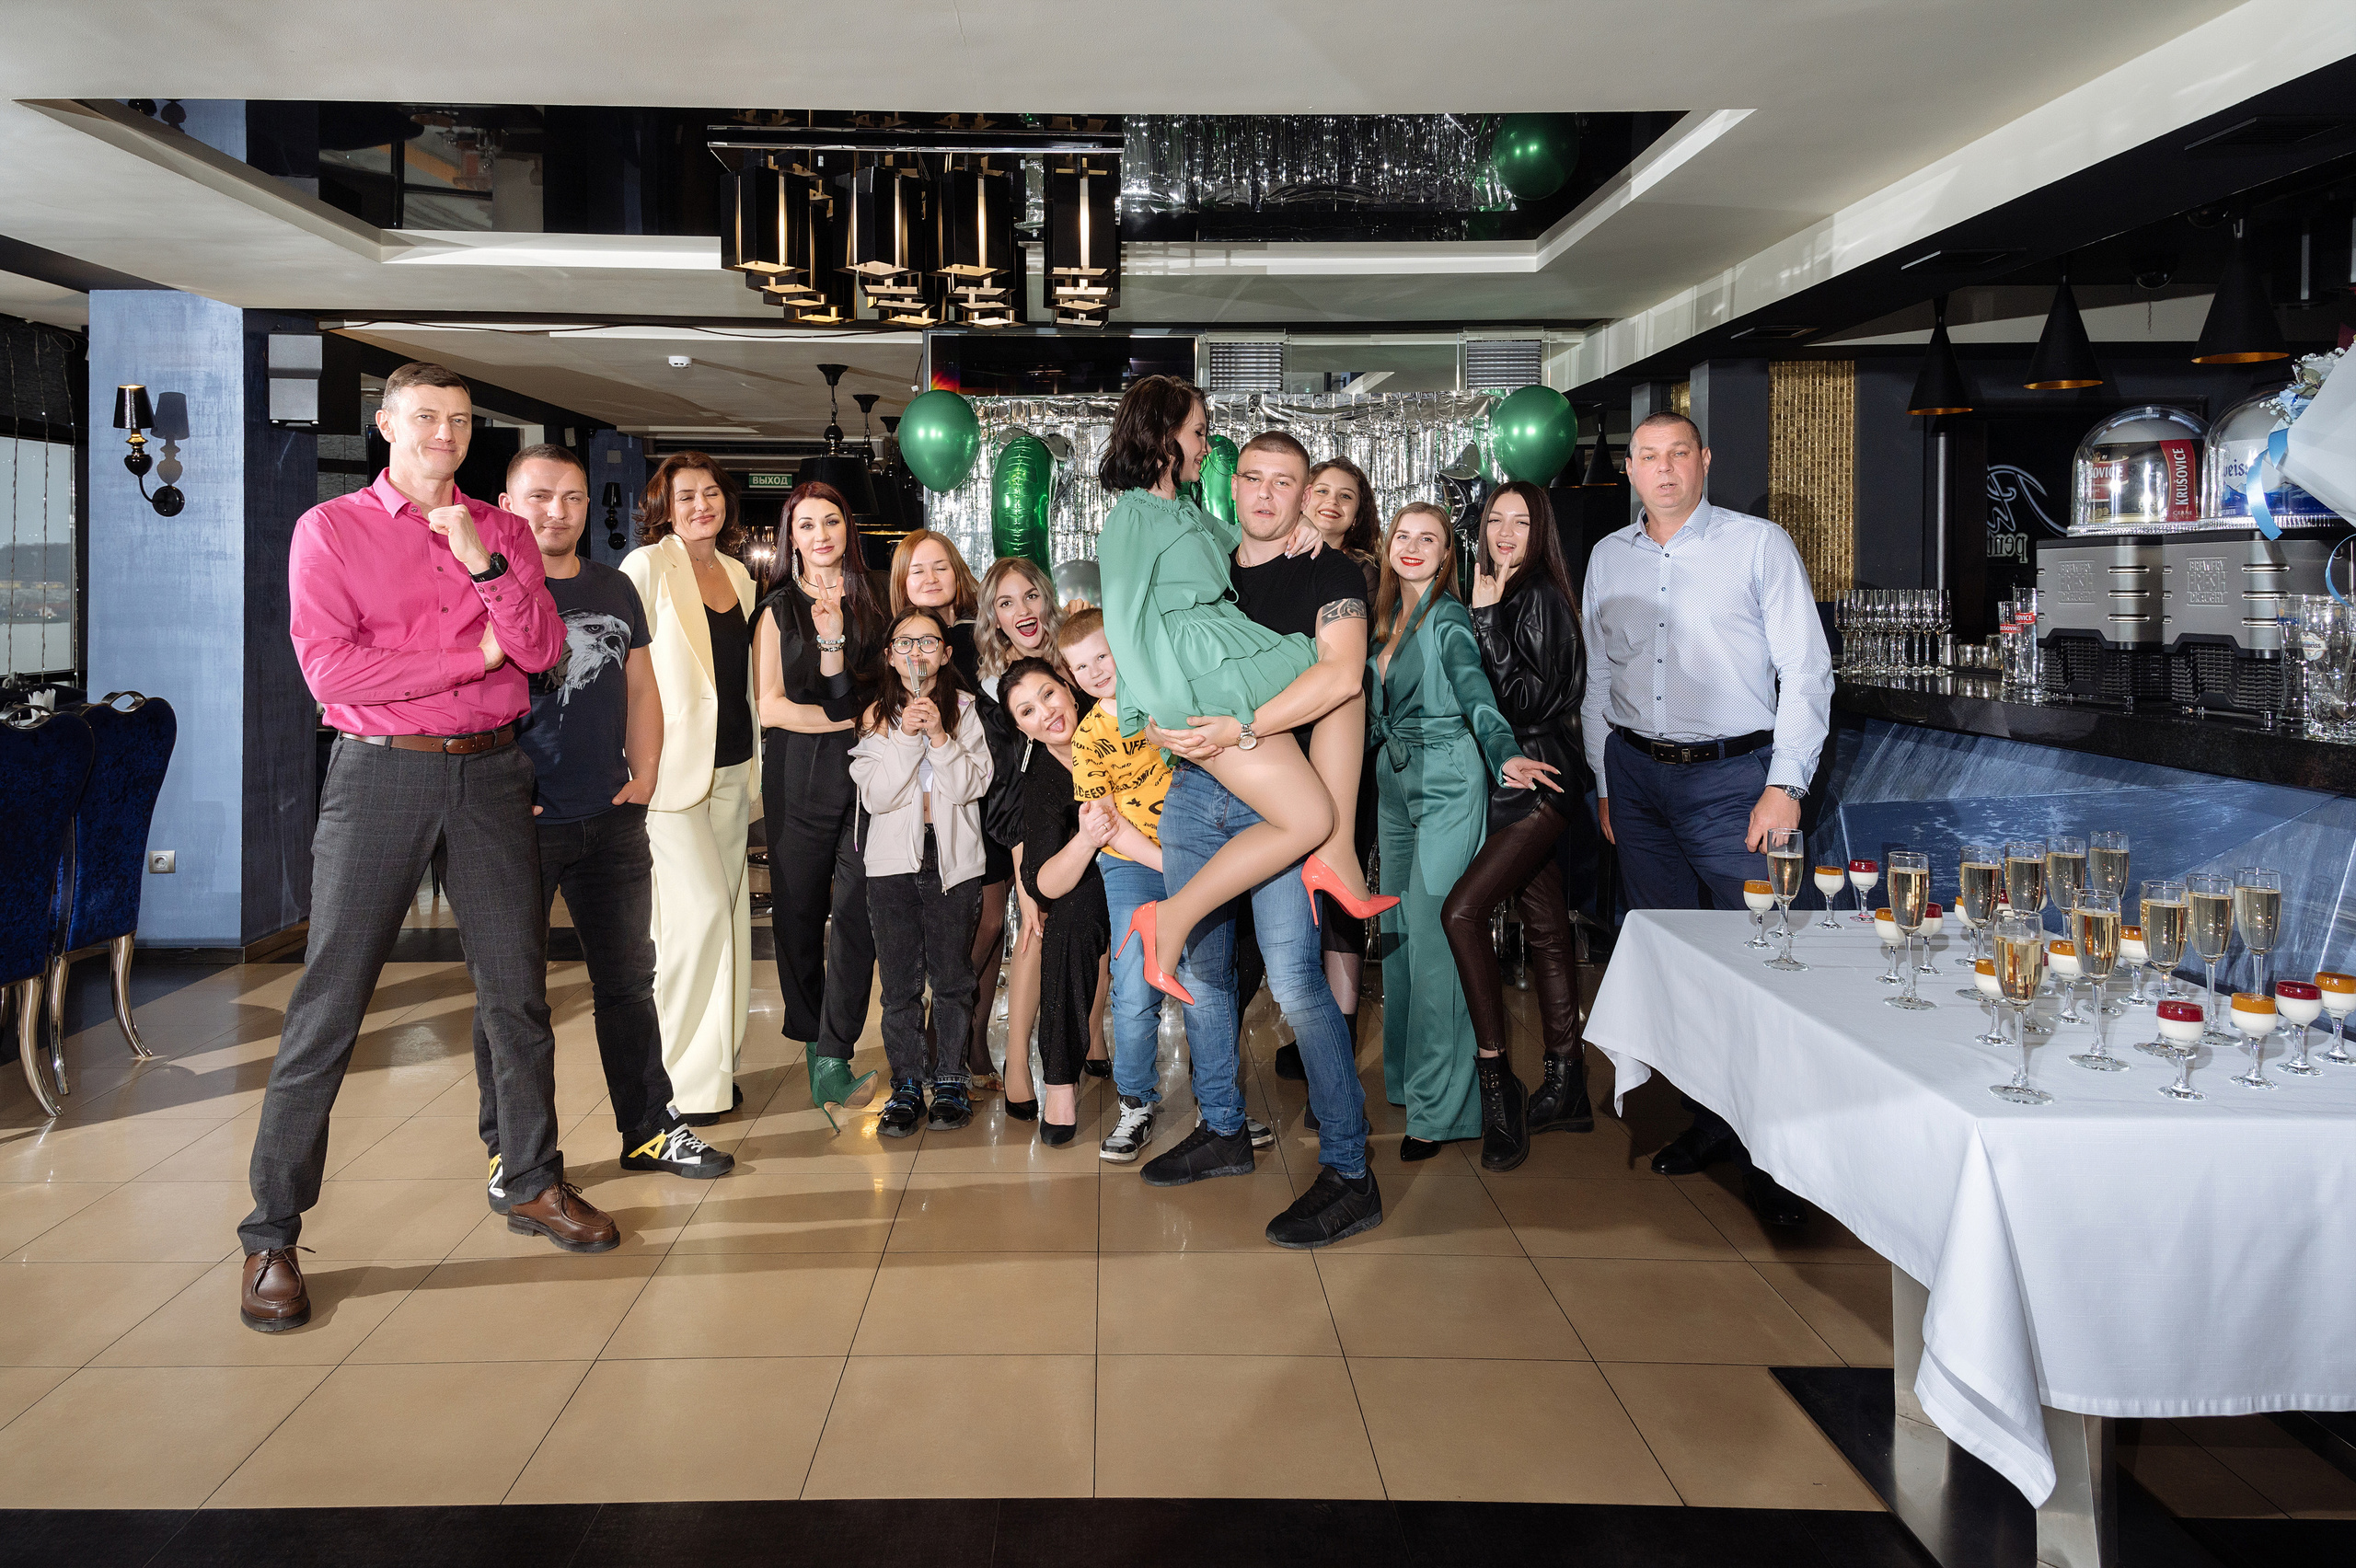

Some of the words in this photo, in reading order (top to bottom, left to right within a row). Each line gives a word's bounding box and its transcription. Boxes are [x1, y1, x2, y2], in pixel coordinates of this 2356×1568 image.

[752, 476, 789, 485] ВЫХОД
[2172, 447, 2189, 505] KRUŠOVICE
[2187, 571, 2227, 591] FRESH
[1122, 738, 1147, 755] LIFE
